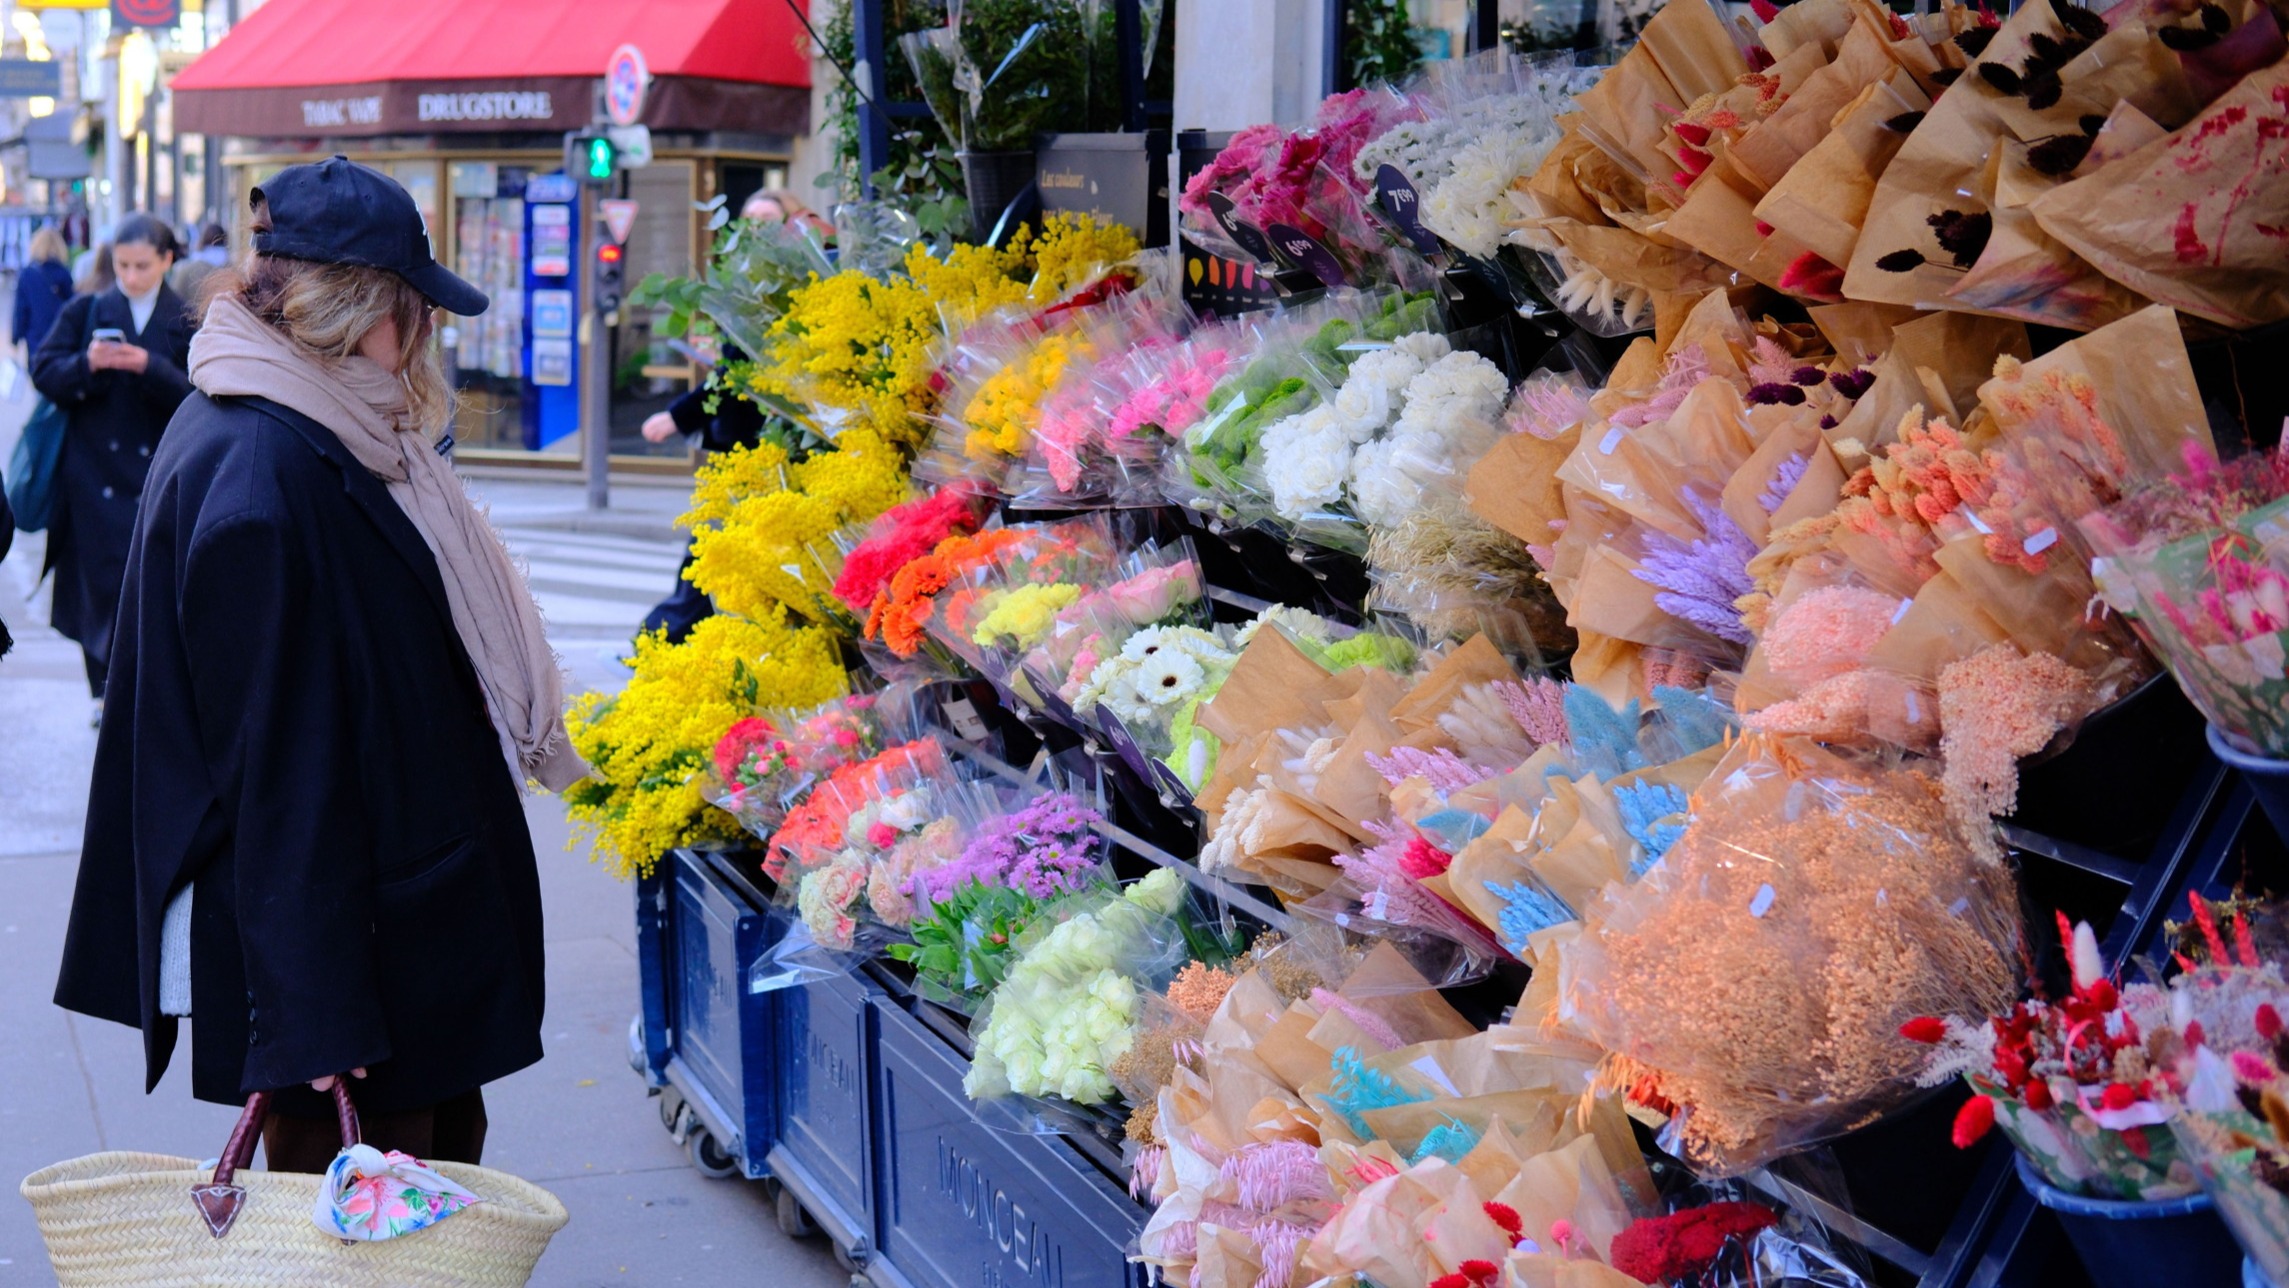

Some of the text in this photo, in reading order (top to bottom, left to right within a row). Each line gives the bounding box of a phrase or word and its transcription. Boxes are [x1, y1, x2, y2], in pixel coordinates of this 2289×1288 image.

[418, 91, 552, 121] DRUGSTORE
[1387, 188, 1415, 212] 7€99
[1285, 239, 1313, 256] 6€99
